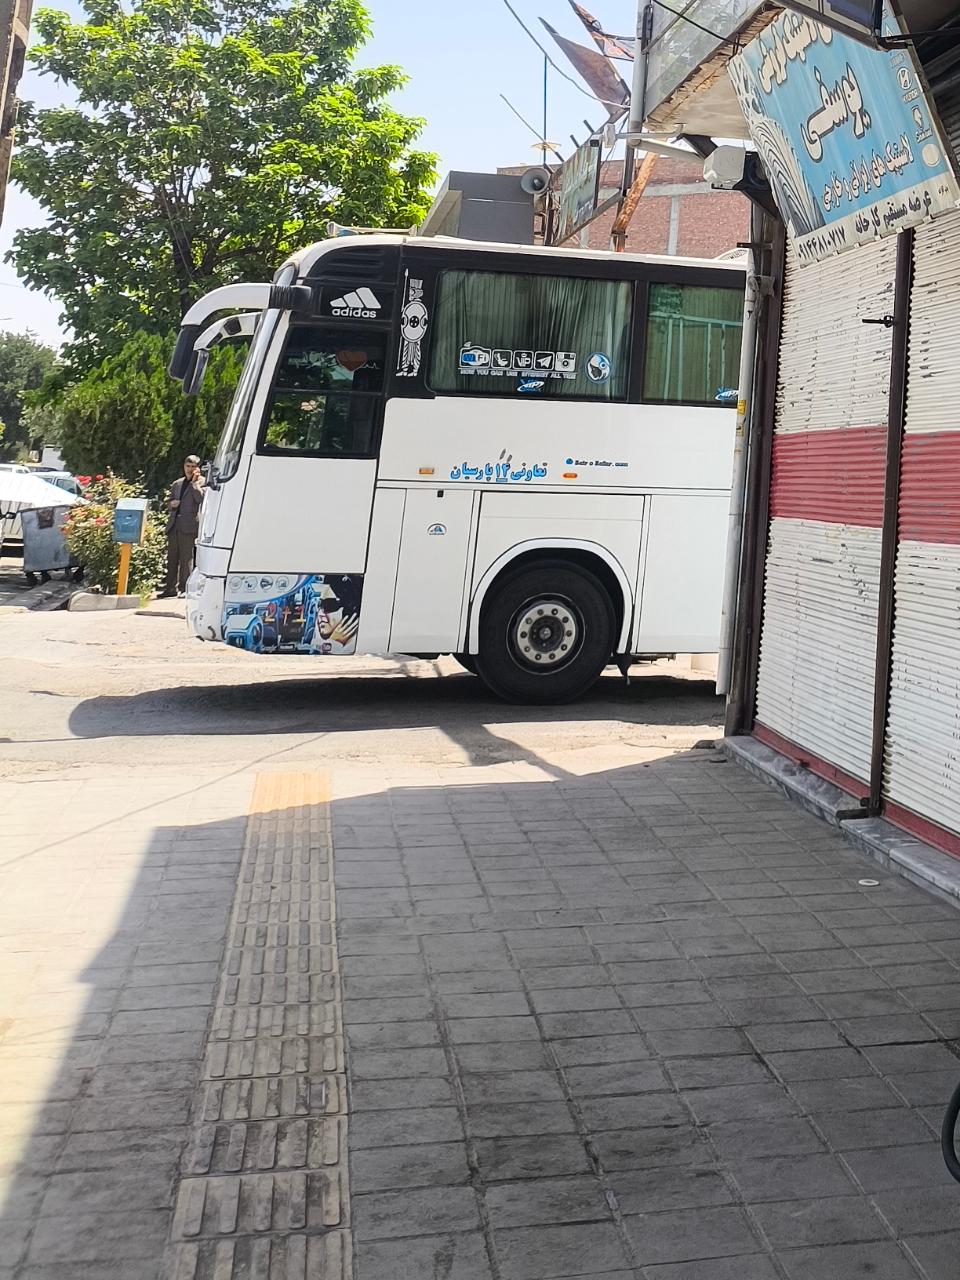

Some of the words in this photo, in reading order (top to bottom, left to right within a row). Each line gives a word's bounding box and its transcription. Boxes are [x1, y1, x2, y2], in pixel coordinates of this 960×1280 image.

[800, 61, 873, 163] یوسفی
[872, 149, 887, 187] های
[885, 131, 915, 177] لاستیک
[331, 307, 377, 318] adidas
[450, 462, 493, 482] پارسیان
[510, 462, 548, 482] تعاونی
